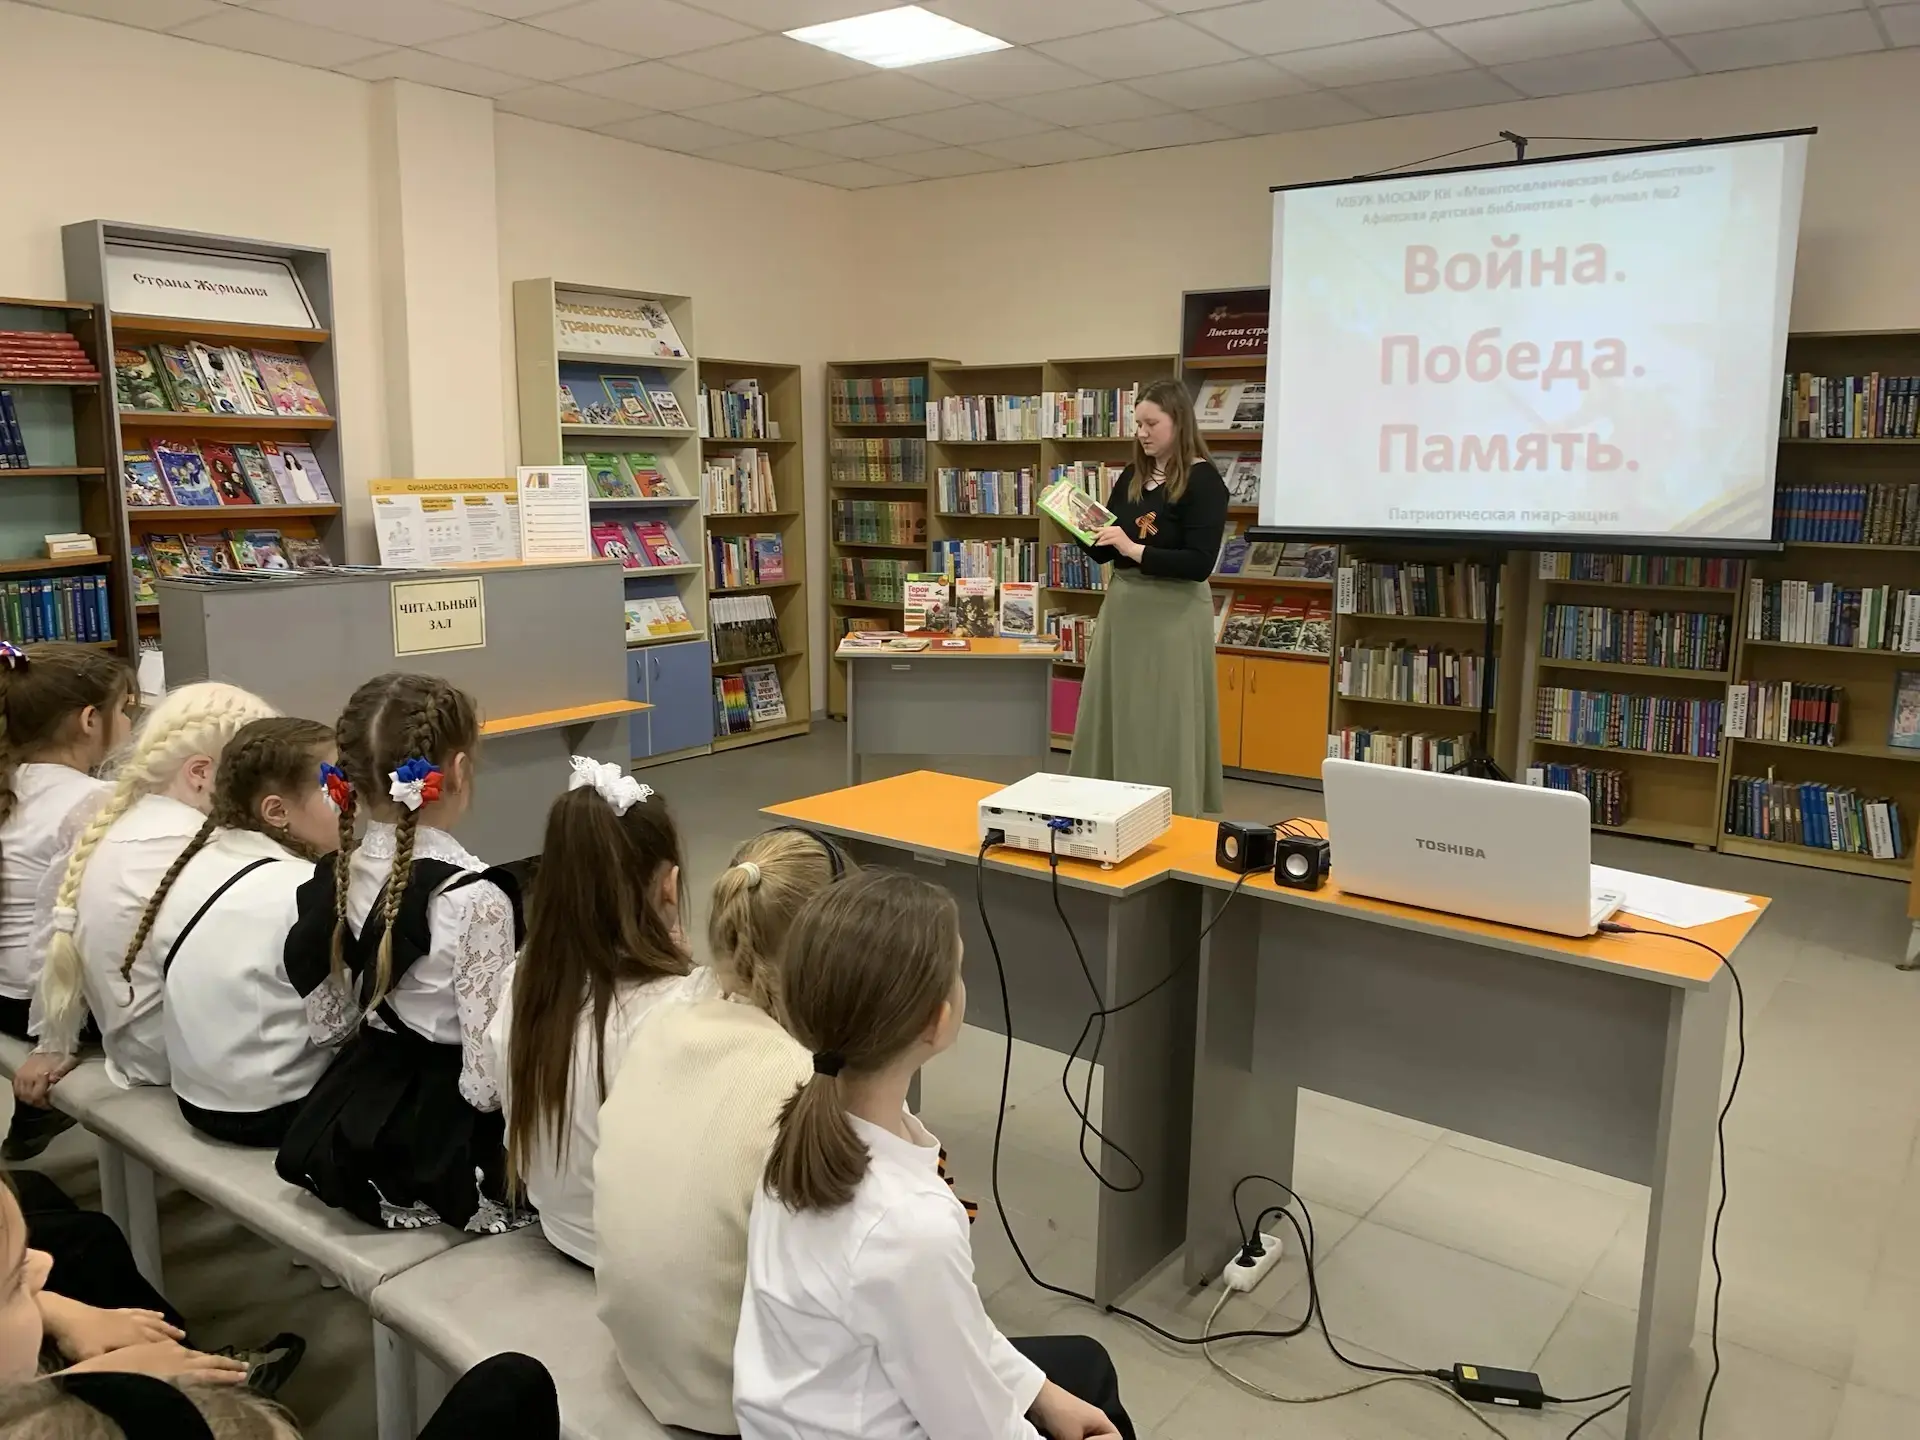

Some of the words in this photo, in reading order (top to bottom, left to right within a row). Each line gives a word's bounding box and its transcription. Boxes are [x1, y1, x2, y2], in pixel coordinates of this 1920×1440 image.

[1402, 233, 1627, 295] Война.
[132, 272, 192, 290] Страна
[196, 278, 269, 298] Журналия
[1206, 327, 1245, 337] Листая
[1226, 338, 1260, 350] (1941
[1380, 326, 1646, 392] Победа.
[1378, 422, 1641, 474] Память.
[407, 483, 459, 492] ФИНАНСОВАЯ
[459, 482, 510, 491] ГРАМОТНОСТЬ
[1388, 506, 1517, 524] Патриотическая
[1520, 508, 1620, 526] пиар-акция
[908, 585, 929, 593] Герои
[399, 596, 478, 615] ЧИТАЛЬНЫЙ
[429, 618, 452, 632] ЗАЛ
[1415, 837, 1486, 859] TOSHIBA
